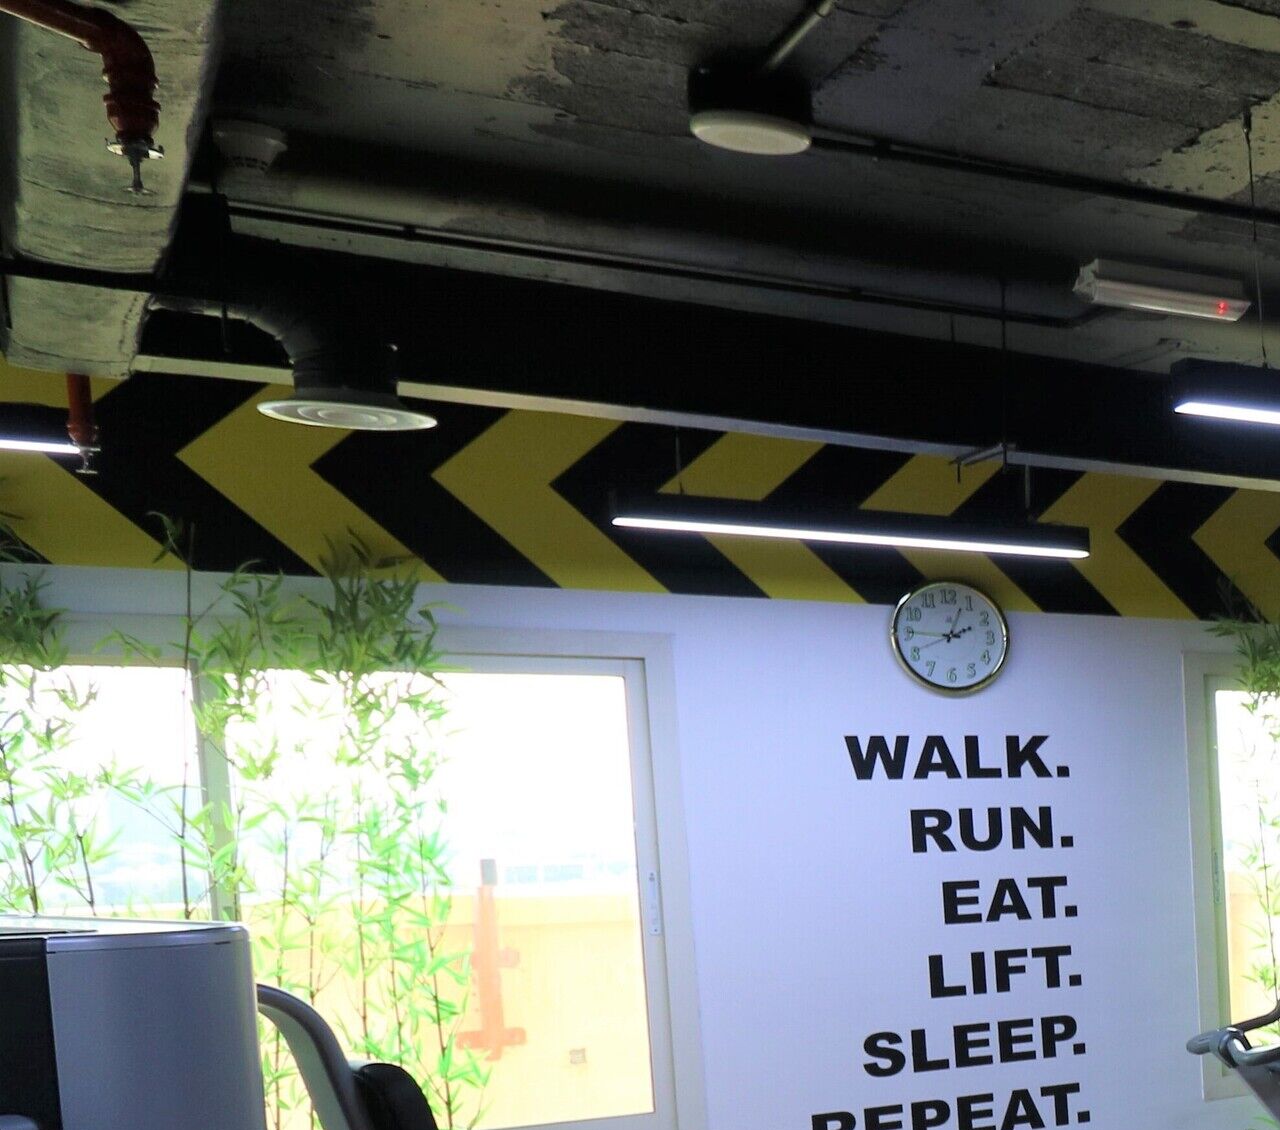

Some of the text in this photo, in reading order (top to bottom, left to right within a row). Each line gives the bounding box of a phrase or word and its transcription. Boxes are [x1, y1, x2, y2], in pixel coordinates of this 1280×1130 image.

[921, 592, 936, 609] 11
[940, 589, 957, 604] 12
[964, 595, 974, 612] 1
[906, 606, 922, 621] 10
[979, 611, 990, 626] 2
[986, 630, 996, 646] 3
[910, 646, 921, 661] 8
[980, 650, 991, 665] 4
[925, 660, 937, 678] 7
[946, 667, 958, 683] 6
[844, 734, 1071, 780] WALK.
[910, 805, 1075, 854] RUN.
[941, 875, 1079, 925] EAT.
[928, 944, 1083, 999] LIFT.
[862, 1014, 1087, 1079] SLEEP.
